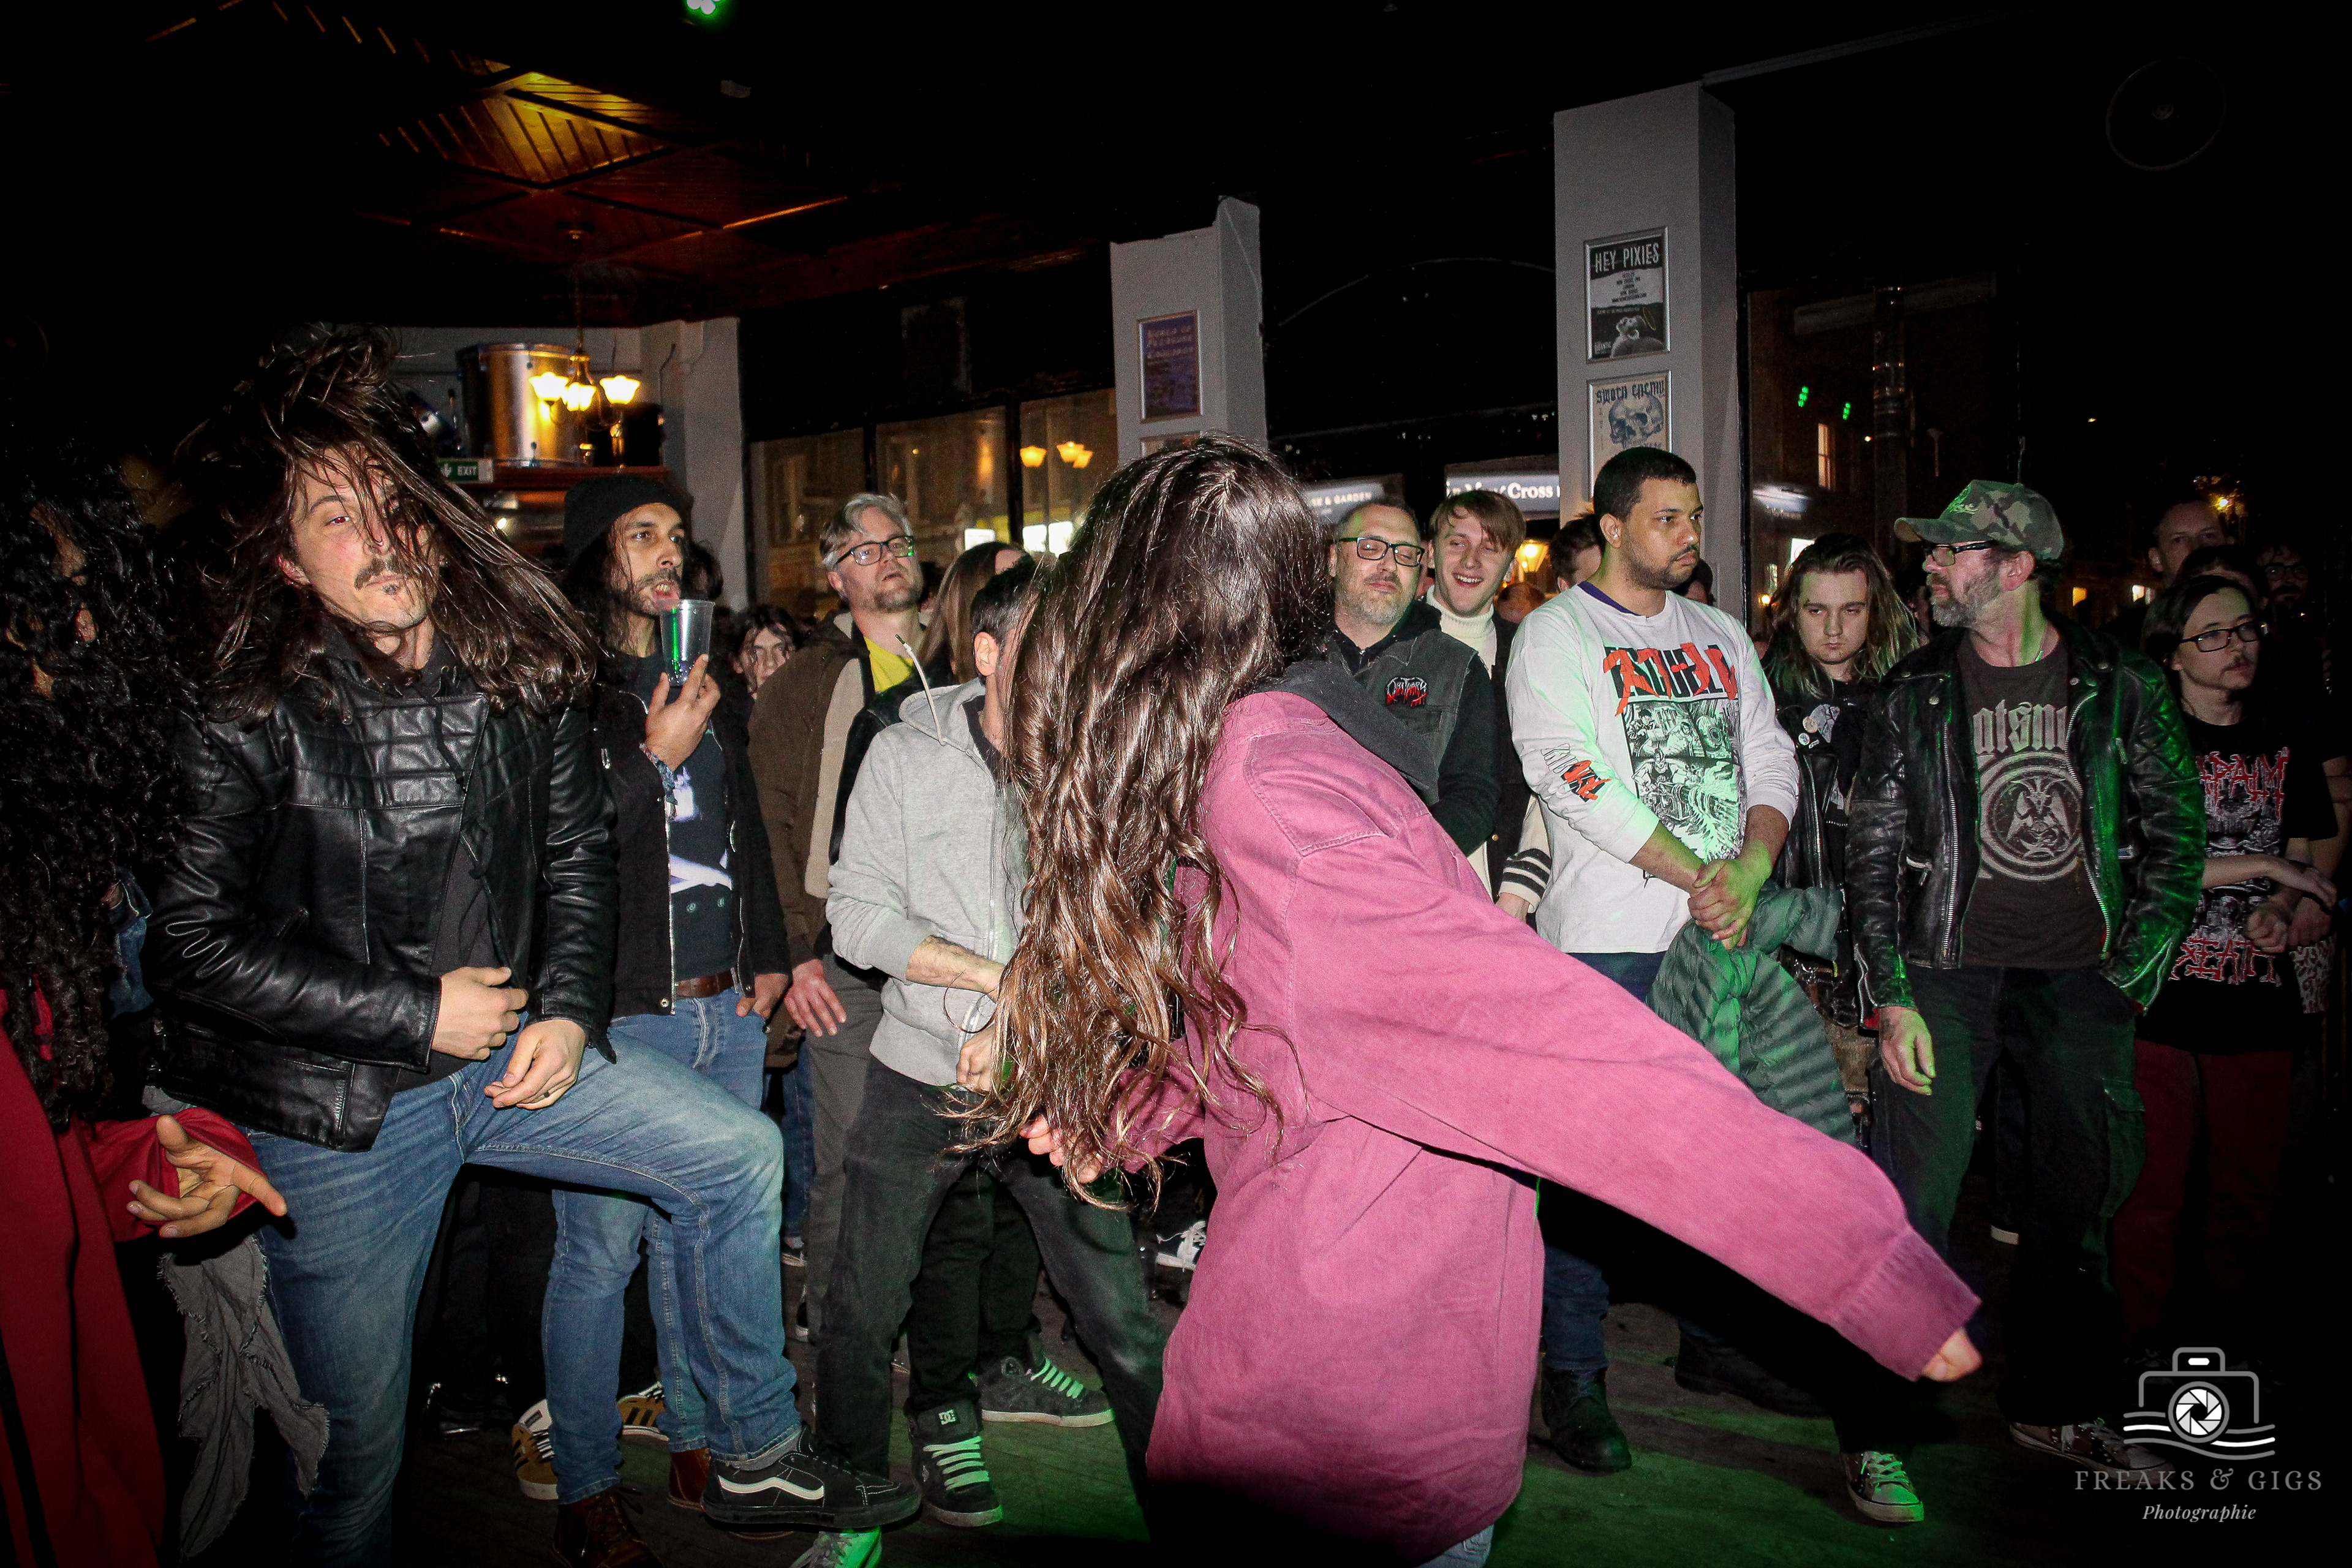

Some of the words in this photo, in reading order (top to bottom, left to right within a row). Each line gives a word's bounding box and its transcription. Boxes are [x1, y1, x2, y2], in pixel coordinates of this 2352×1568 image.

[1595, 248, 1616, 273] HEY
[1623, 243, 1660, 268] PIXIES
[458, 466, 477, 476] EXIT
[1507, 483, 1554, 499] Cross
[1333, 492, 1373, 505] GARDEN
